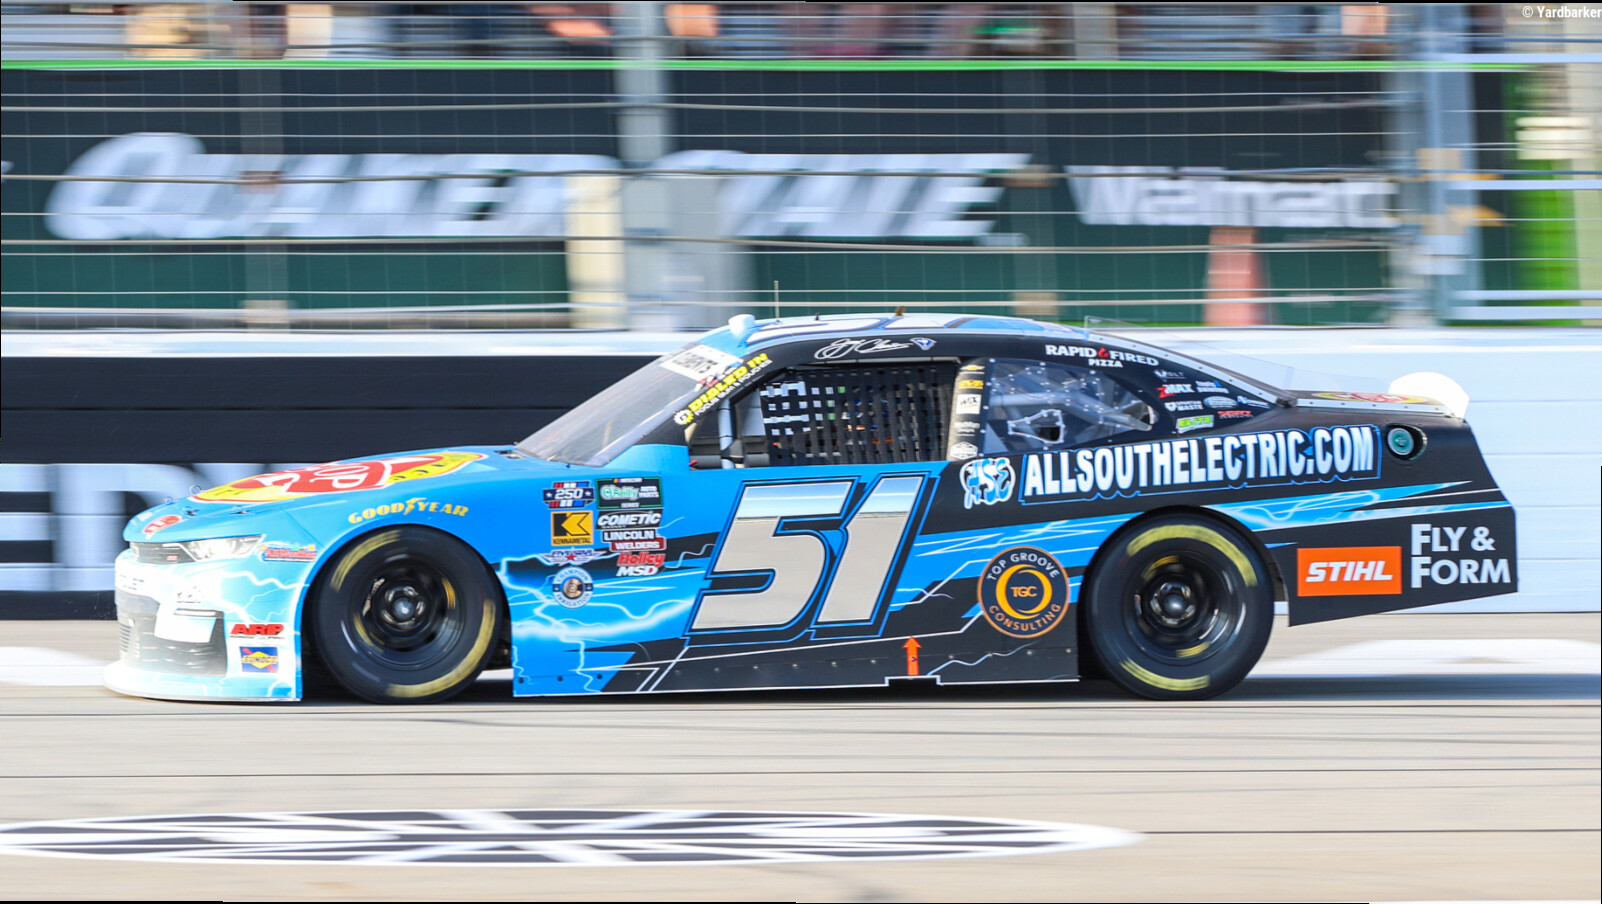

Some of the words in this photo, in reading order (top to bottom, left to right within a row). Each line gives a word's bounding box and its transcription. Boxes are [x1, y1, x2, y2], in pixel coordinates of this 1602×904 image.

[1045, 344, 1097, 358] RAPID
[1108, 352, 1160, 367] FIRED
[1088, 358, 1124, 369] PIZZA
[688, 365, 749, 412] DIALED
[746, 353, 769, 369] IN
[1023, 426, 1374, 498] ALLSOUTHELECTRIC.COM
[554, 488, 584, 500] 250
[347, 497, 470, 524] GOODYEAR
[603, 530, 655, 541] LINCOLN
[614, 541, 660, 550] WELDERS
[1411, 523, 1468, 556] FLY
[1470, 526, 1497, 551] &
[617, 551, 667, 568] Holley
[688, 474, 926, 632] 51
[615, 565, 659, 577] MSD
[986, 559, 1007, 581] TOP
[1009, 552, 1061, 579] GROOVE
[1305, 560, 1394, 583] STIHL
[1411, 556, 1512, 589] FORM
[1010, 585, 1038, 598] TGC
[988, 603, 1062, 632] CONSULTING
[230, 623, 285, 636] ARP
